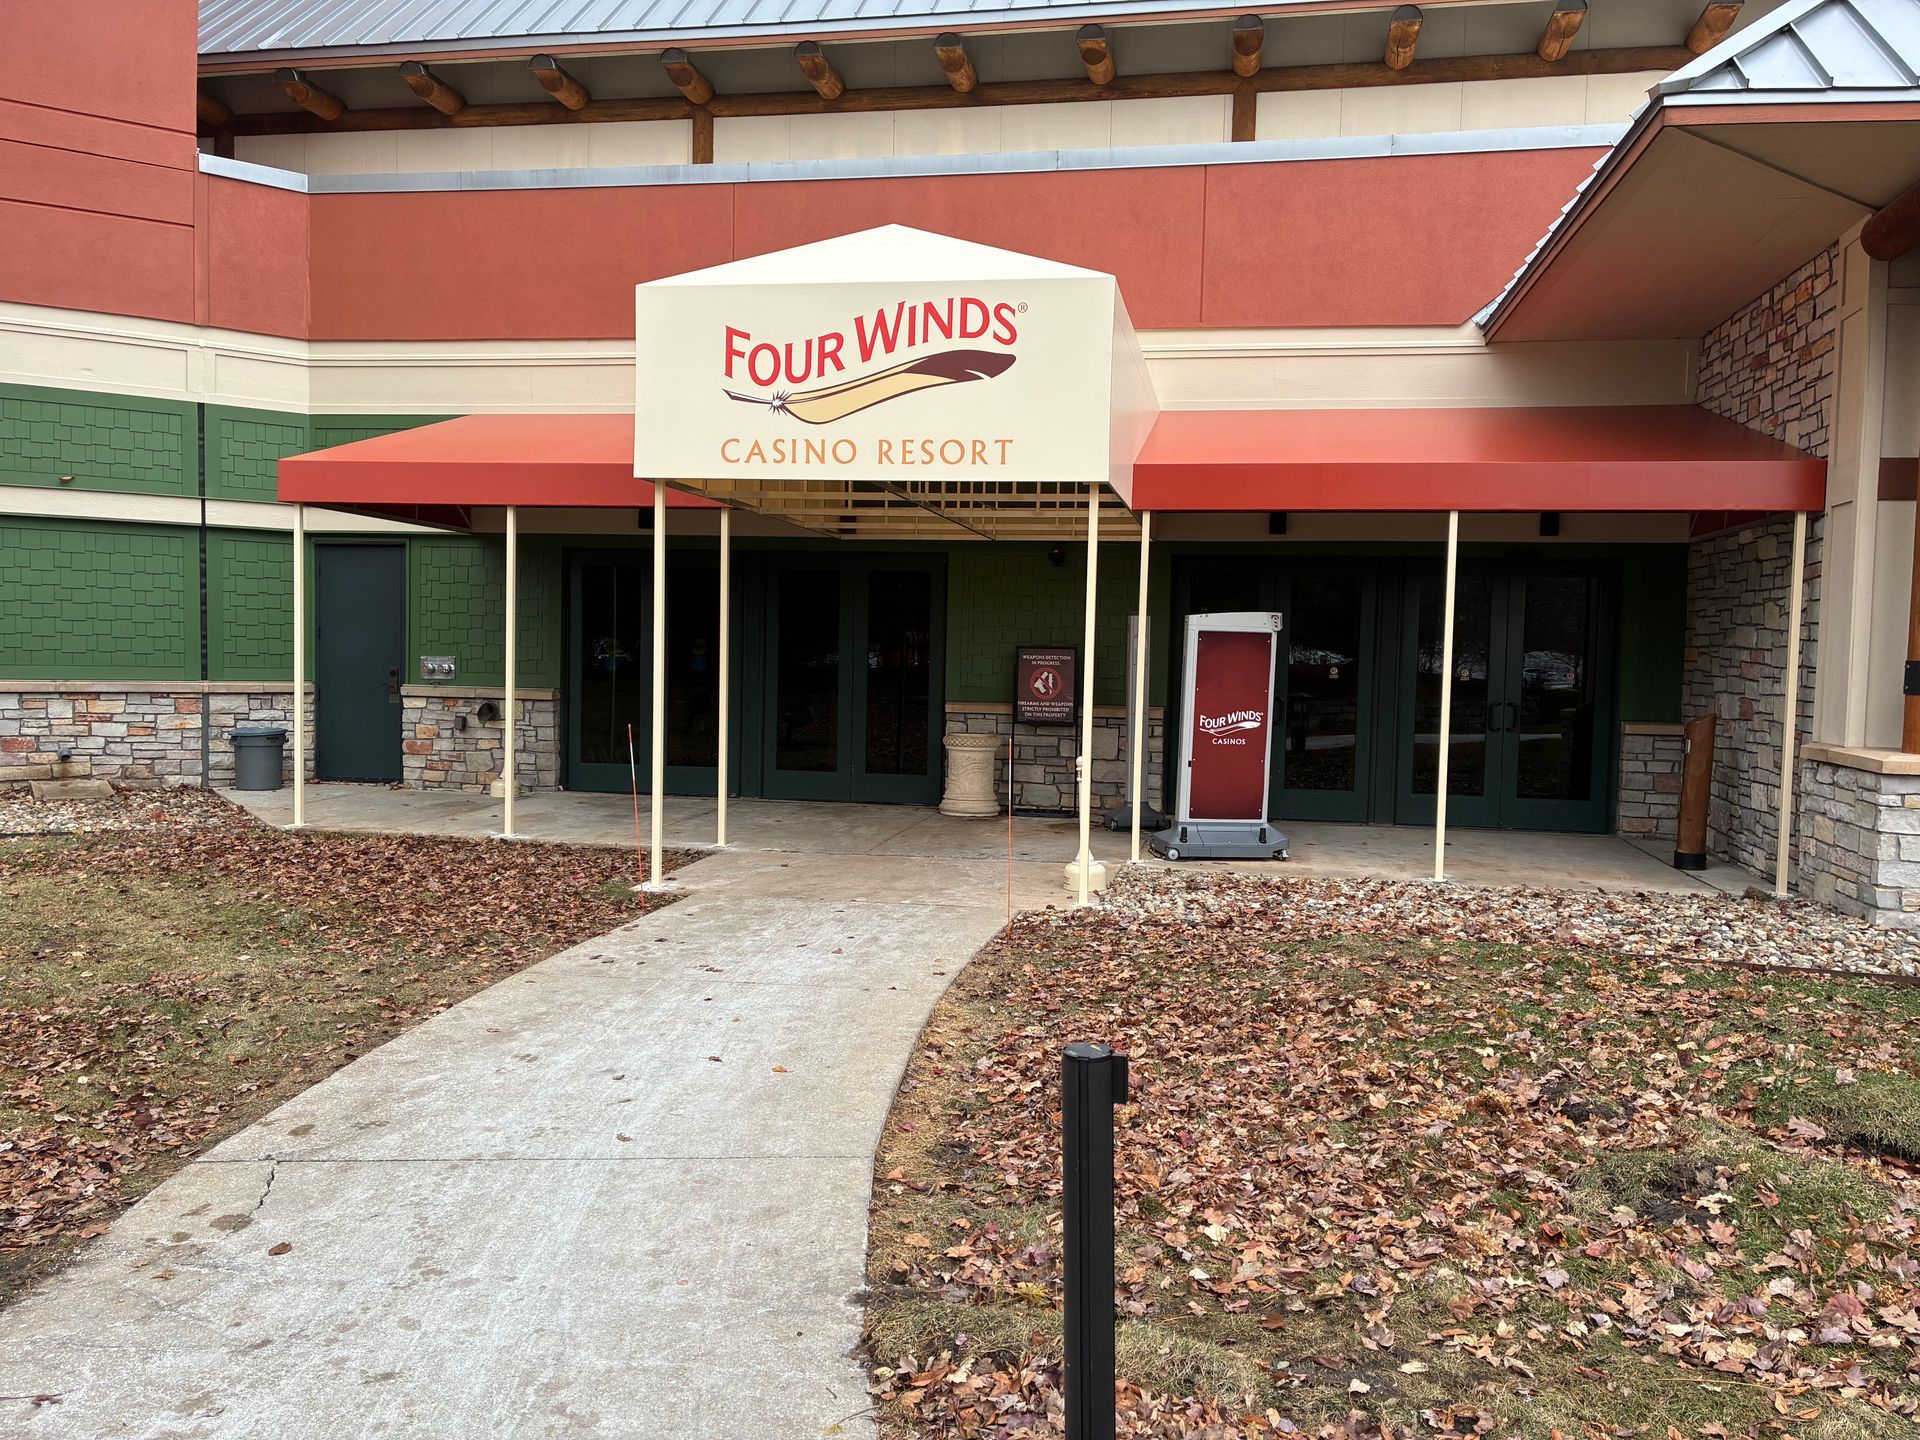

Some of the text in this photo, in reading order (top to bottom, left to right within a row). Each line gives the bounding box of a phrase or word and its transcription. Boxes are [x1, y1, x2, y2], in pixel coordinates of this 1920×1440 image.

[724, 325, 846, 386] FOUR
[720, 438, 1014, 465] CASINO RESORT
[1200, 714, 1226, 728] FOUR
